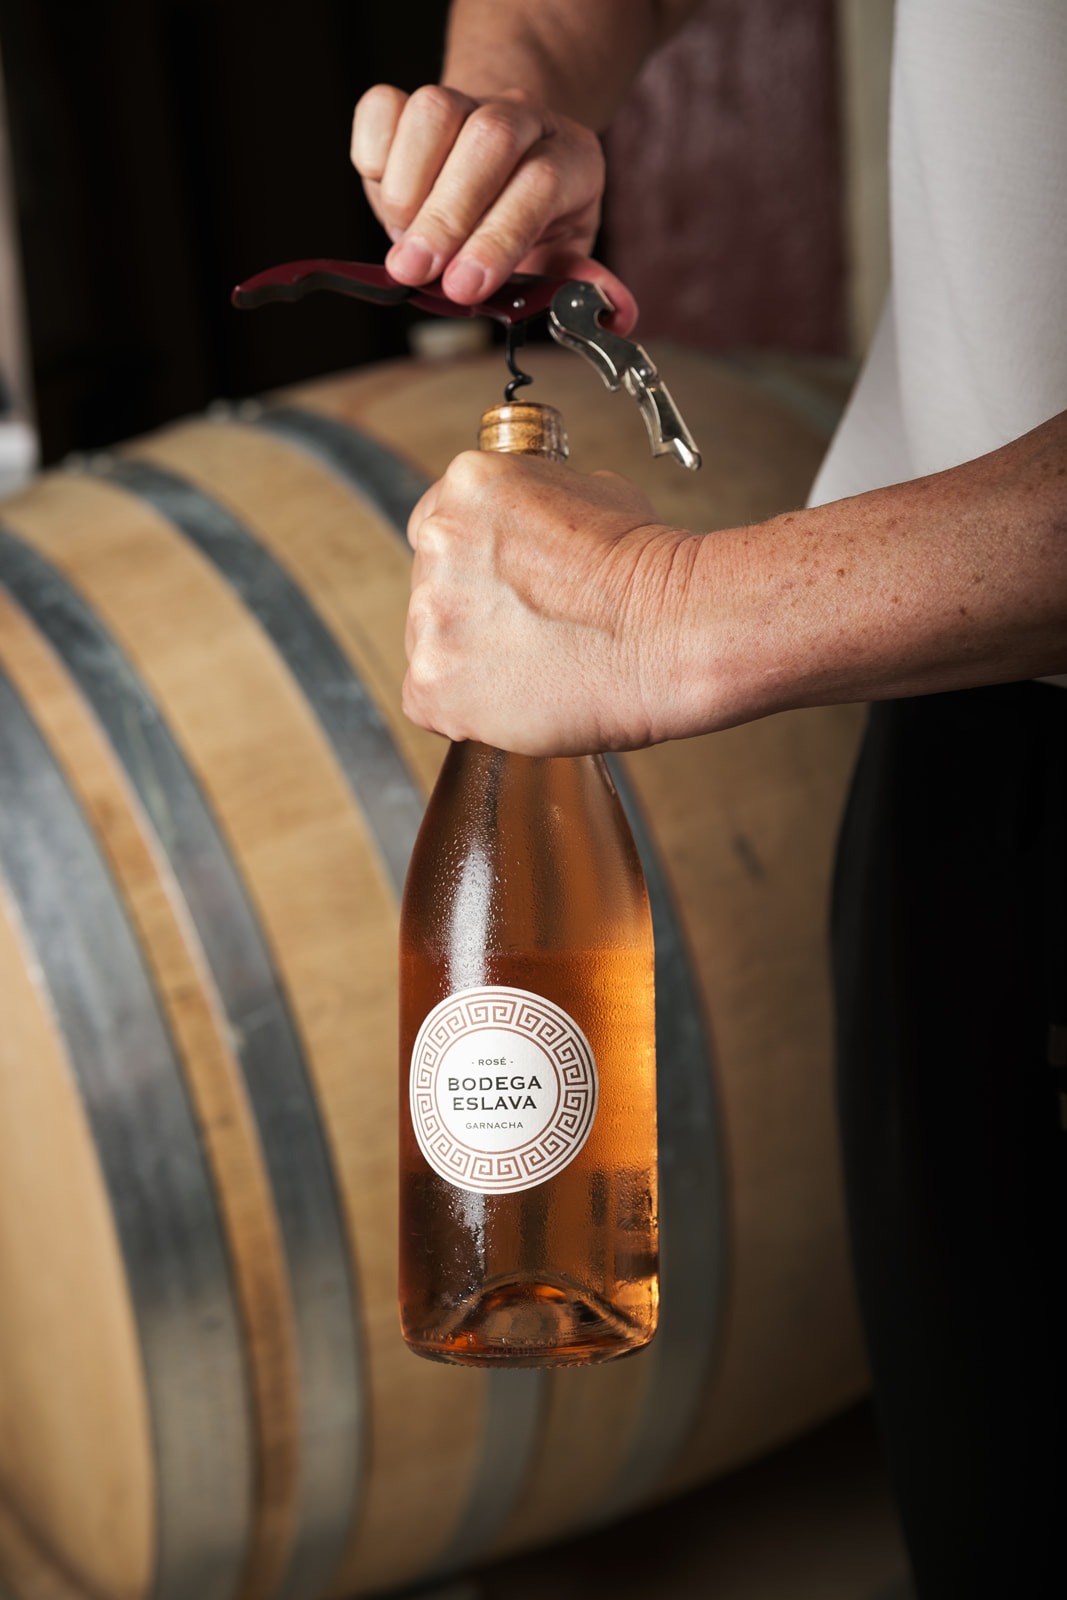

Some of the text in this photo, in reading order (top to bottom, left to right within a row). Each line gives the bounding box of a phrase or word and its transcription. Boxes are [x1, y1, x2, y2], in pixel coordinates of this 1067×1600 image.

[478, 1057, 507, 1066] ROSÉ
[448, 1075, 543, 1091] BODEGA
[453, 1095, 538, 1111] ESLAVA
[465, 1121, 524, 1130] GARNACHA
